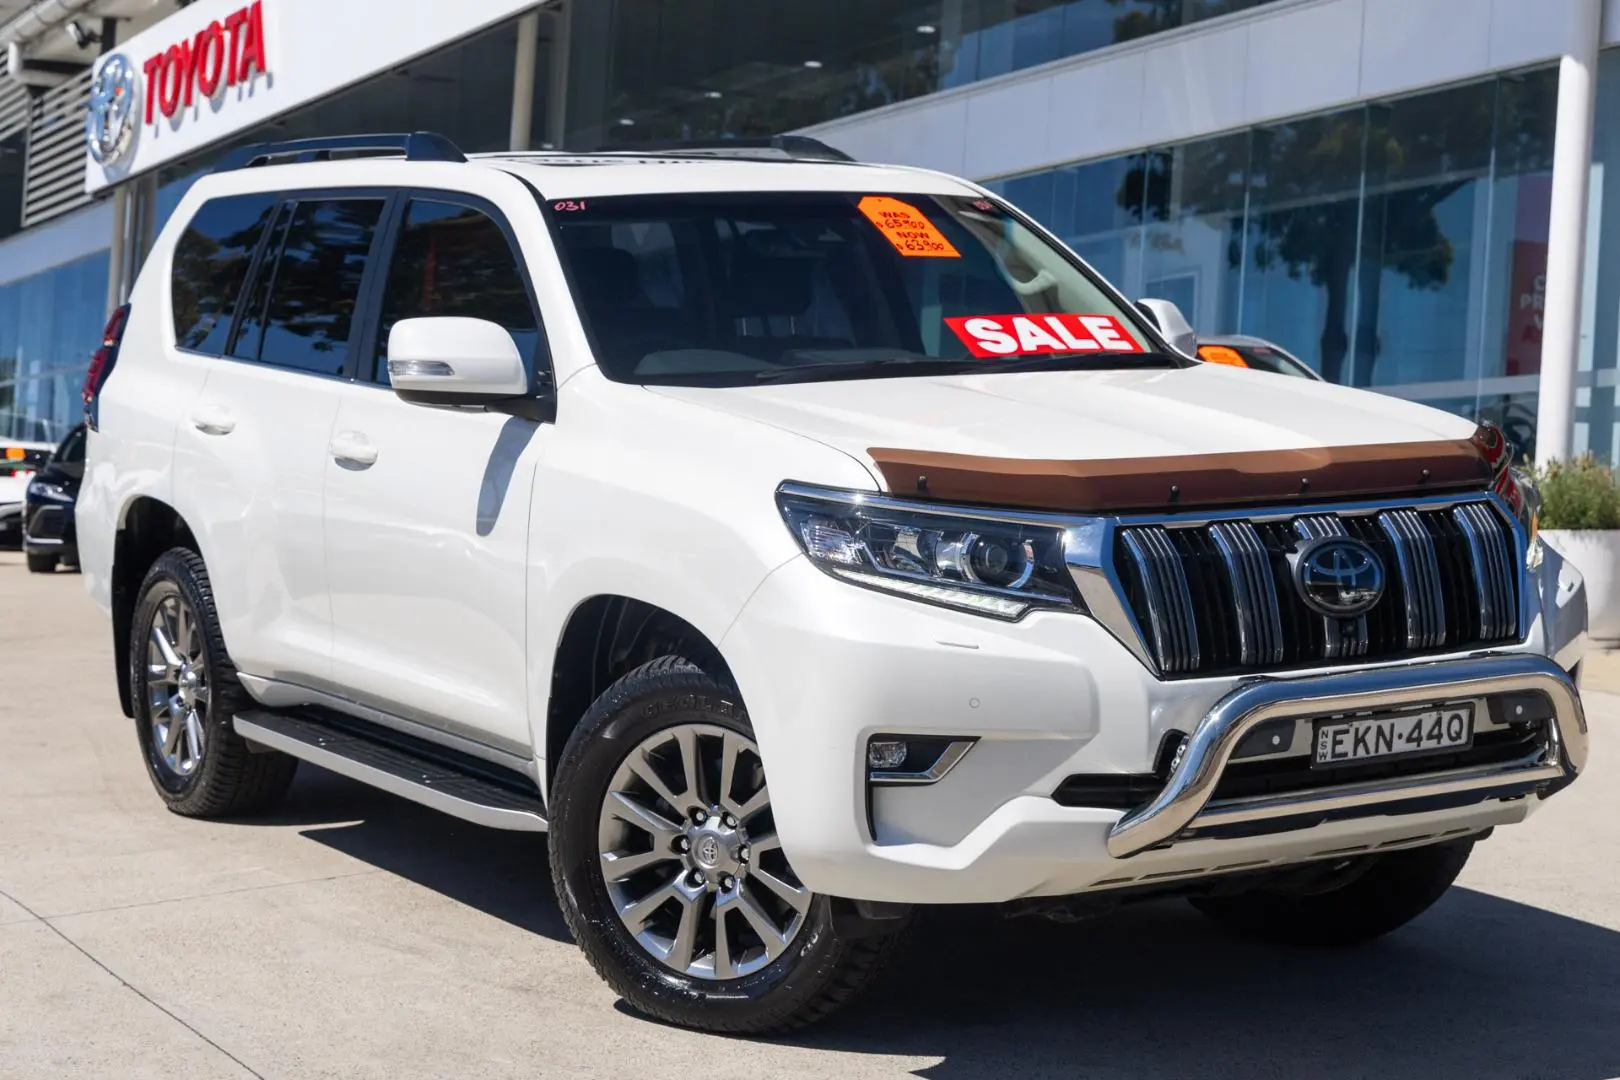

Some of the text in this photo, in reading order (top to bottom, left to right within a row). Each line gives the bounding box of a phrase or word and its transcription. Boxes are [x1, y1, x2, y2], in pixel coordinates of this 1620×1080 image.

[143, 0, 266, 126] TOYOTA
[554, 201, 586, 211] 031
[878, 211, 911, 219] WAS
[896, 231, 930, 239] NOW
[964, 316, 1134, 354] SALE
